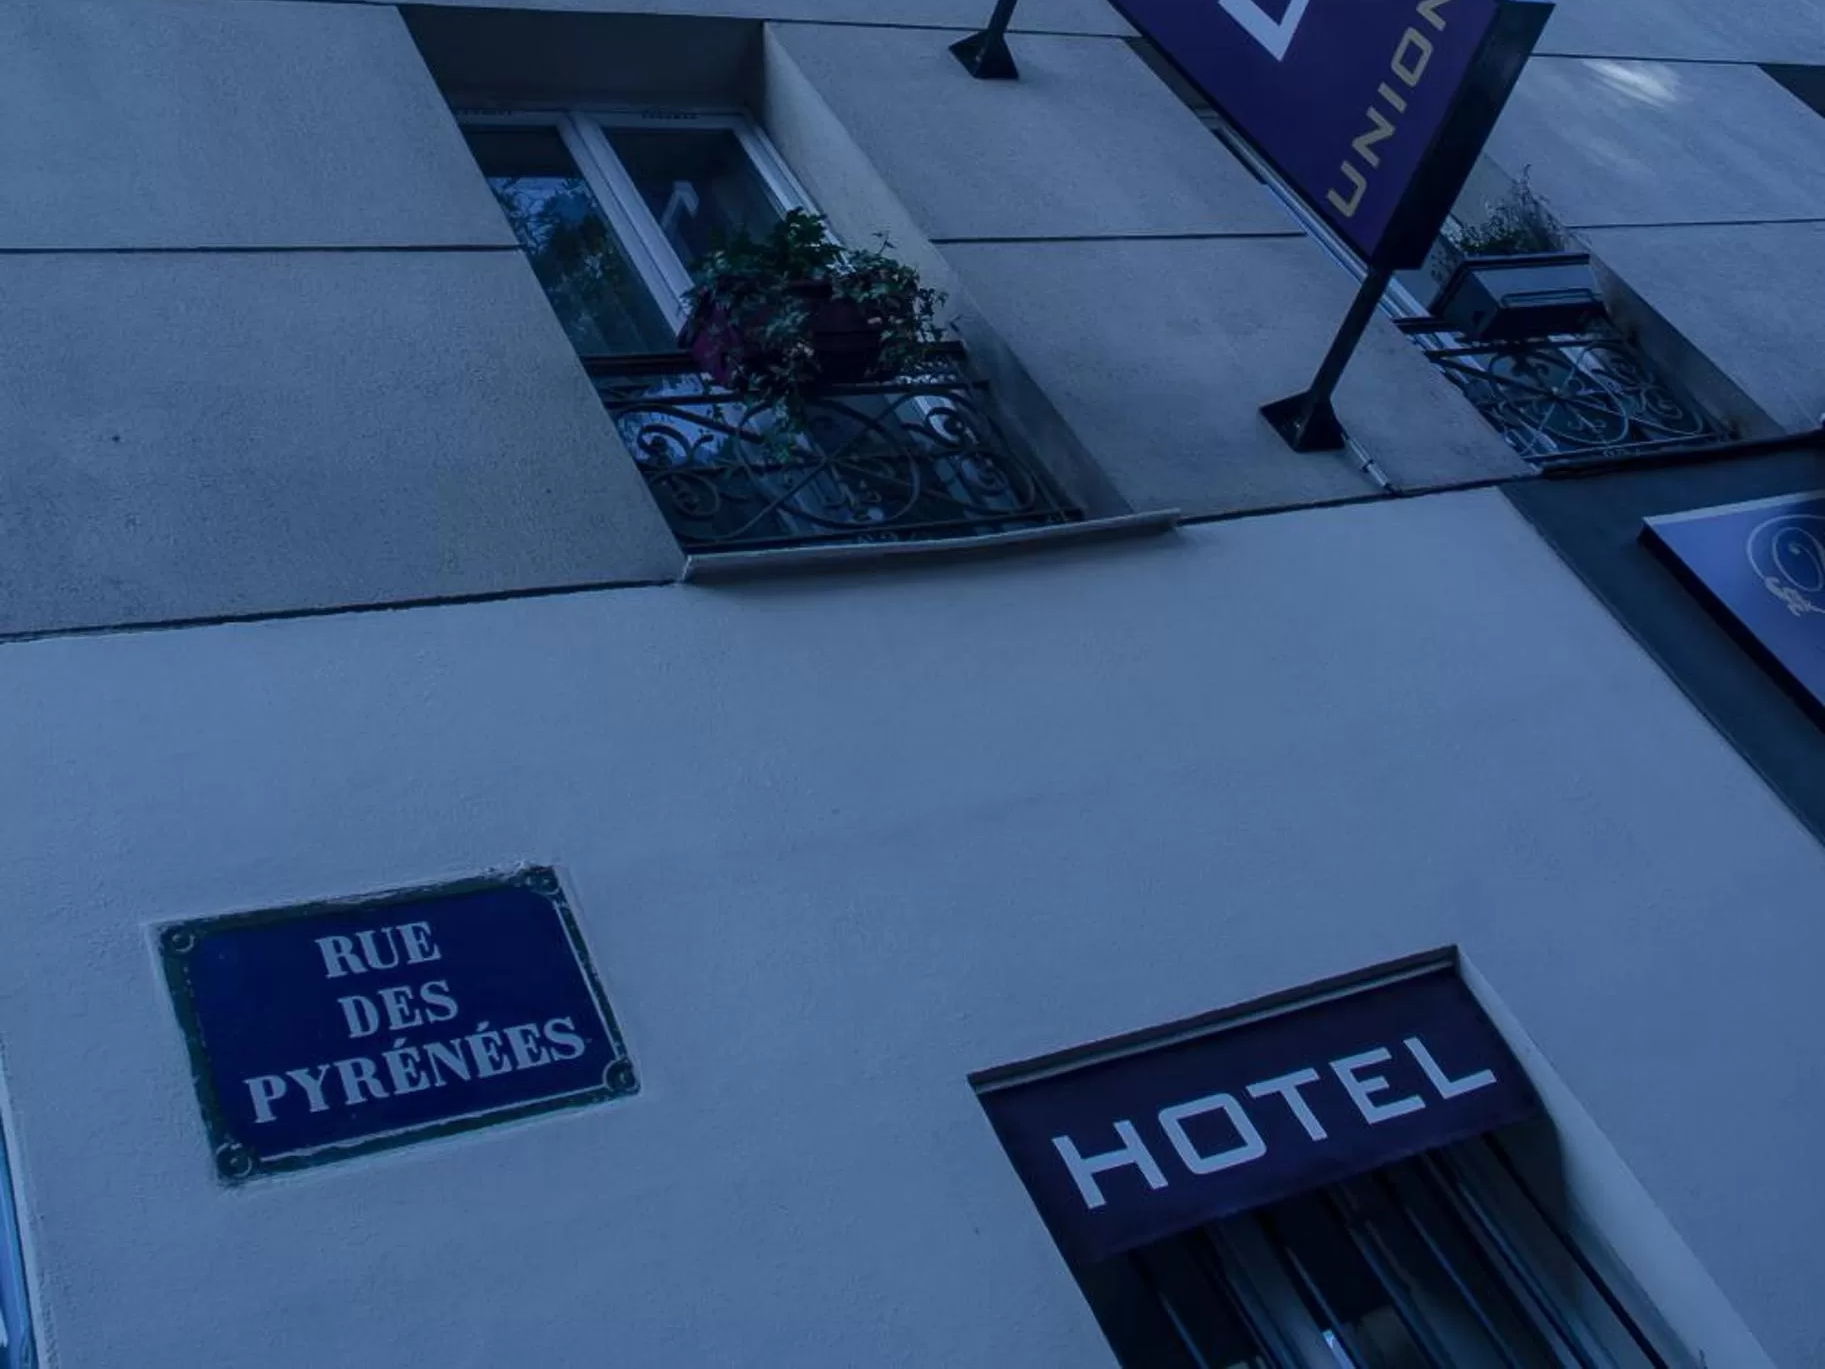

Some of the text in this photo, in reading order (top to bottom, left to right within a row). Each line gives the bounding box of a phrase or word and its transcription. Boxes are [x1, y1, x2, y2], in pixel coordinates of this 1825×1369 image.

[314, 921, 442, 979] RUE
[337, 980, 459, 1038] DES
[243, 1017, 587, 1123] PYRÉNÉES
[1051, 1036, 1497, 1209] HOTEL
